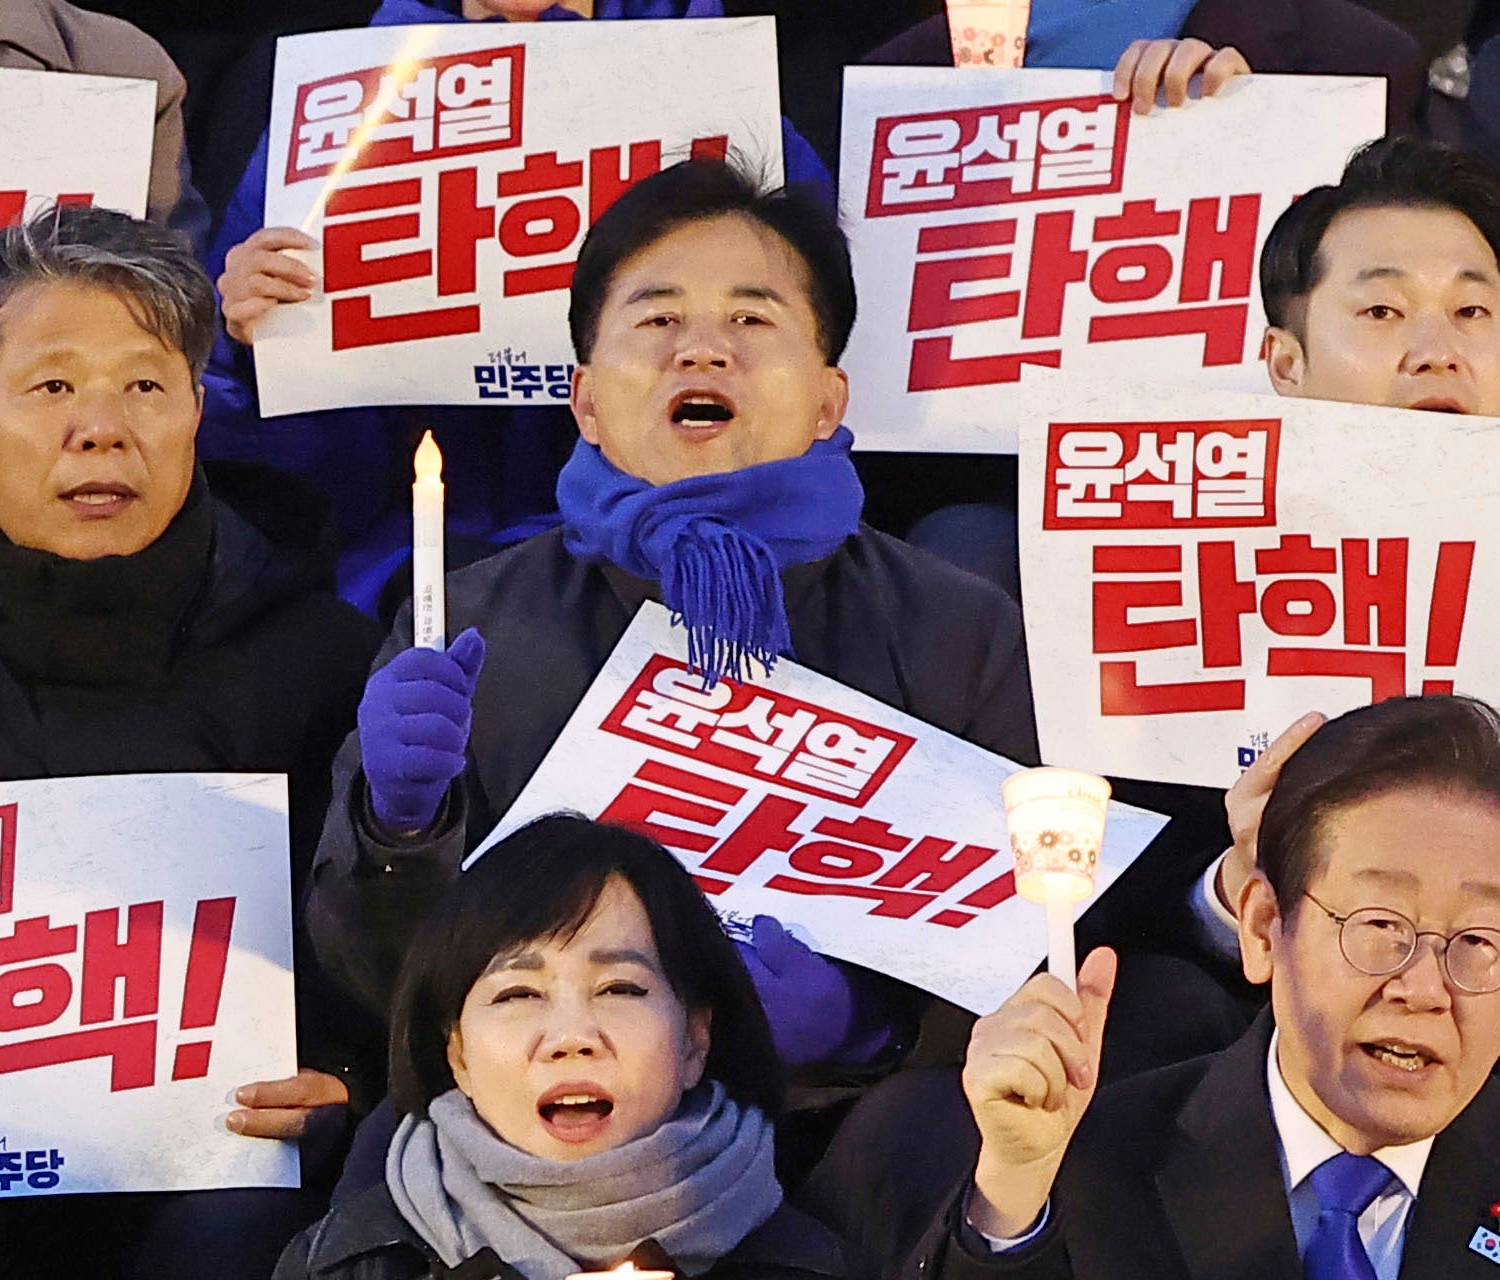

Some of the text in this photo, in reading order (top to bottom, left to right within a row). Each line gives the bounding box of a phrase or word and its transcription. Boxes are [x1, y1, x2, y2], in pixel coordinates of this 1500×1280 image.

[298, 58, 512, 172] 윤석열
[884, 105, 1114, 203] 윤석열
[323, 136, 727, 351] 탄핵
[907, 193, 1280, 392] 탄핵
[475, 363, 577, 400] 민주당
[1055, 429, 1266, 519] 윤석열
[1093, 535, 1475, 716] 탄핵!
[627, 665, 897, 798] 윤석열
[602, 759, 1020, 927] 탄핵!
